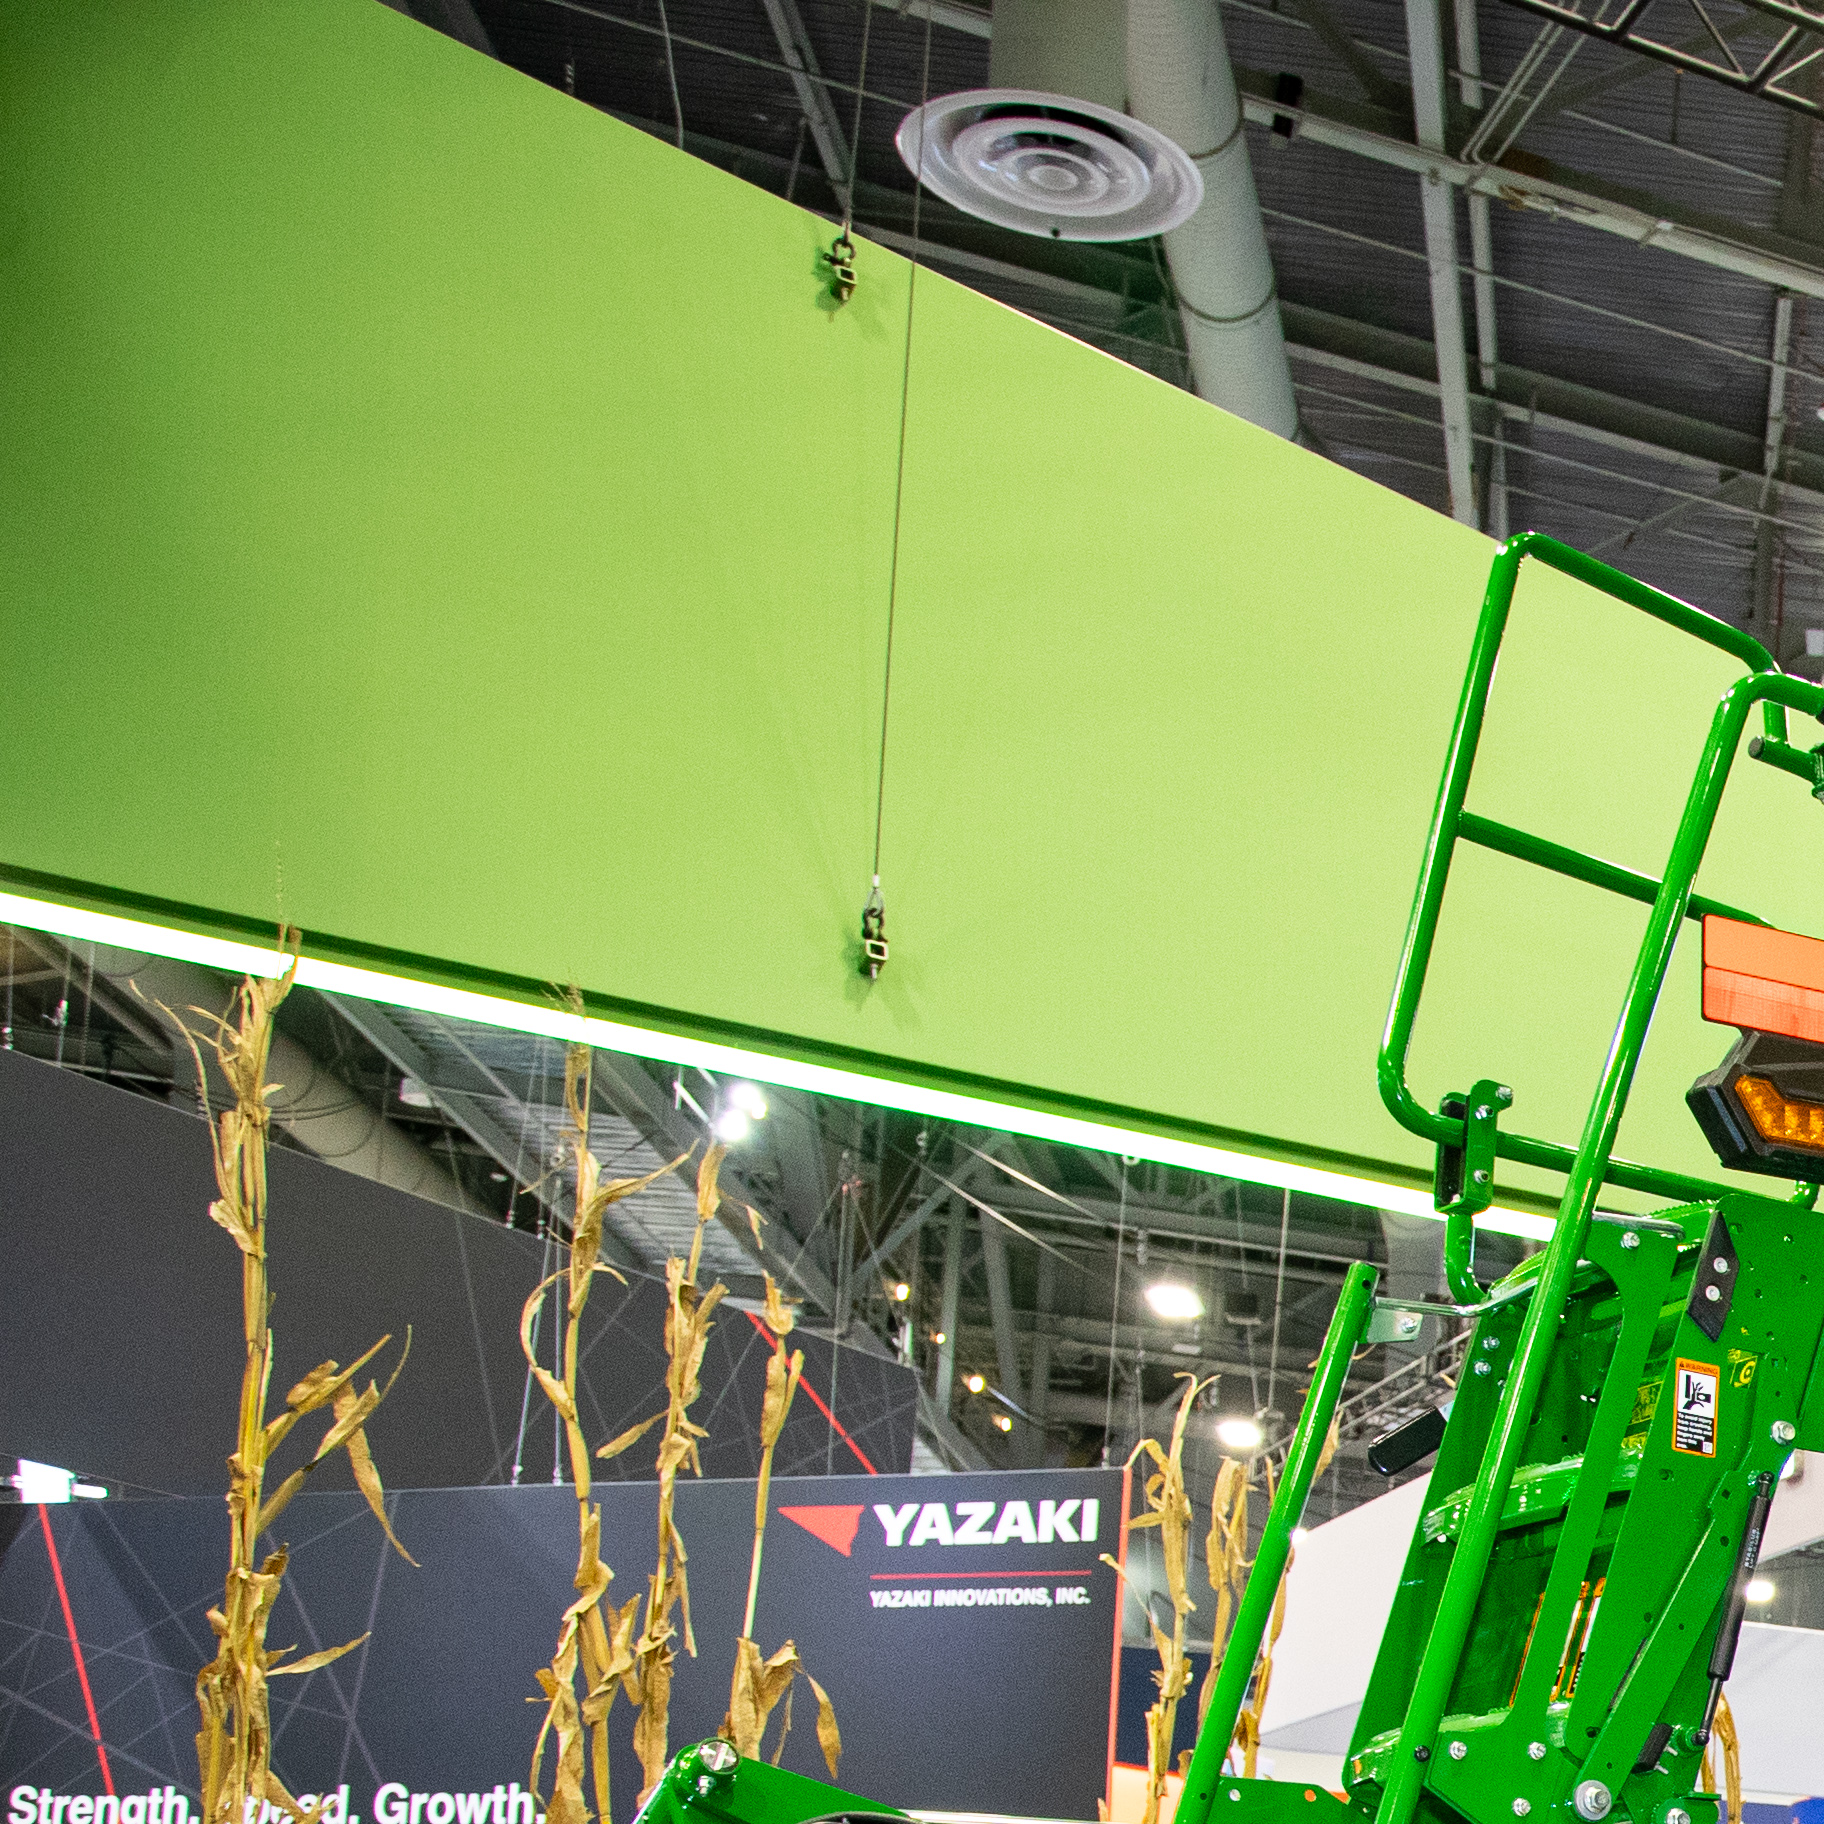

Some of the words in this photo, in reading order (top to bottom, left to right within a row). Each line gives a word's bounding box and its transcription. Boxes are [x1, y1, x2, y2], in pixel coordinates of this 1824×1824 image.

[873, 1498, 1100, 1547] YAZAKI
[870, 1589, 931, 1608] YAZAKI
[933, 1587, 1053, 1608] INNOVATIONS,
[1055, 1587, 1091, 1605] INC.
